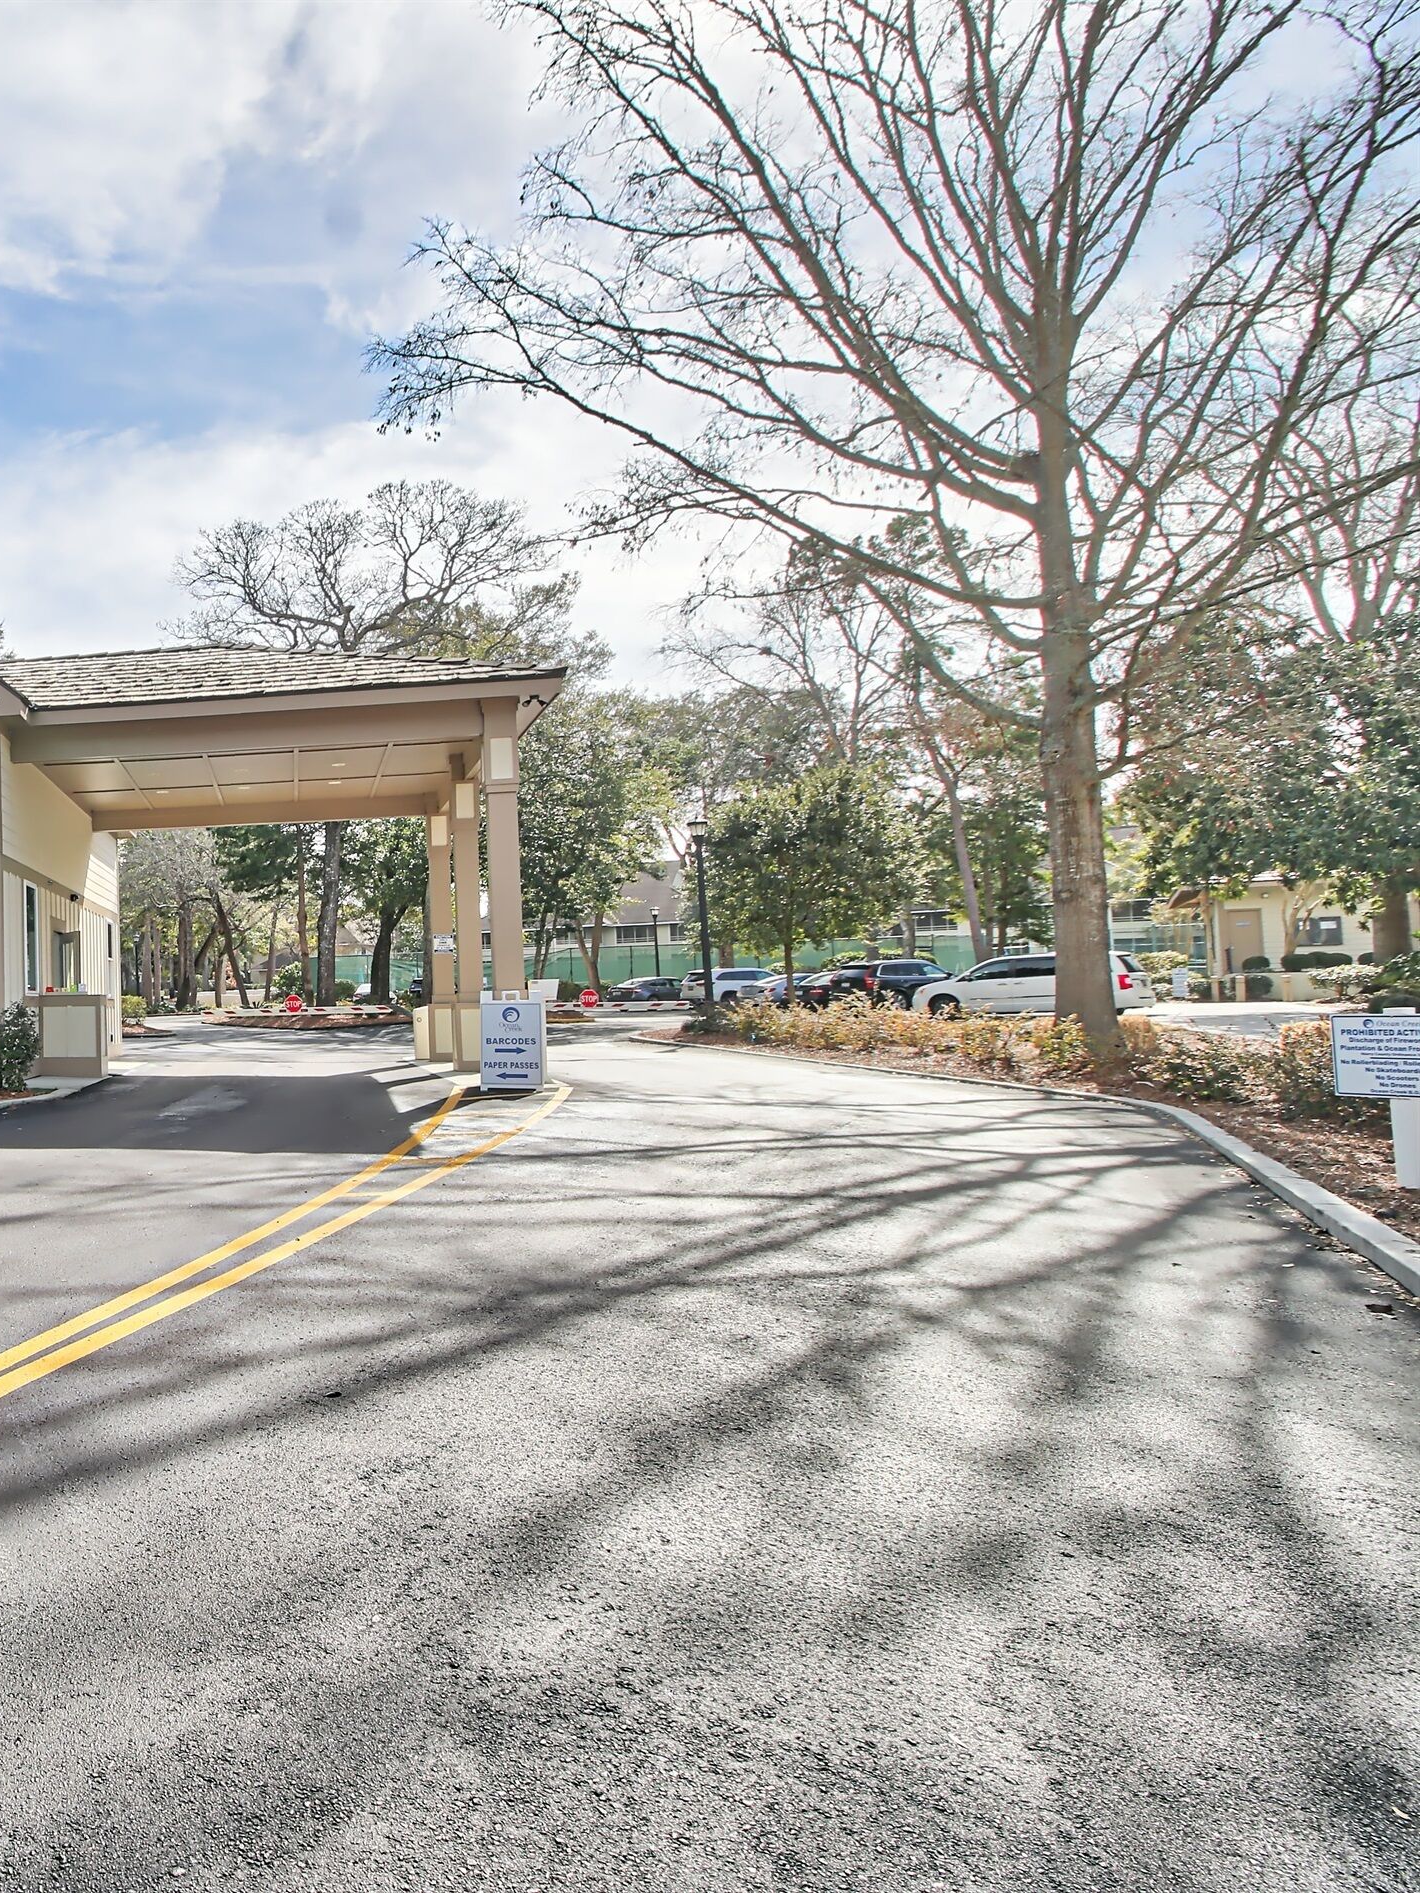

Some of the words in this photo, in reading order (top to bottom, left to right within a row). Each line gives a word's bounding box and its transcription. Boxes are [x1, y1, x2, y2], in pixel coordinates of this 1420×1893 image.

[581, 995, 597, 1003] STOP
[485, 1037, 536, 1045] BARCODES
[483, 1061, 508, 1069] PAPER
[510, 1061, 539, 1069] PASSES
